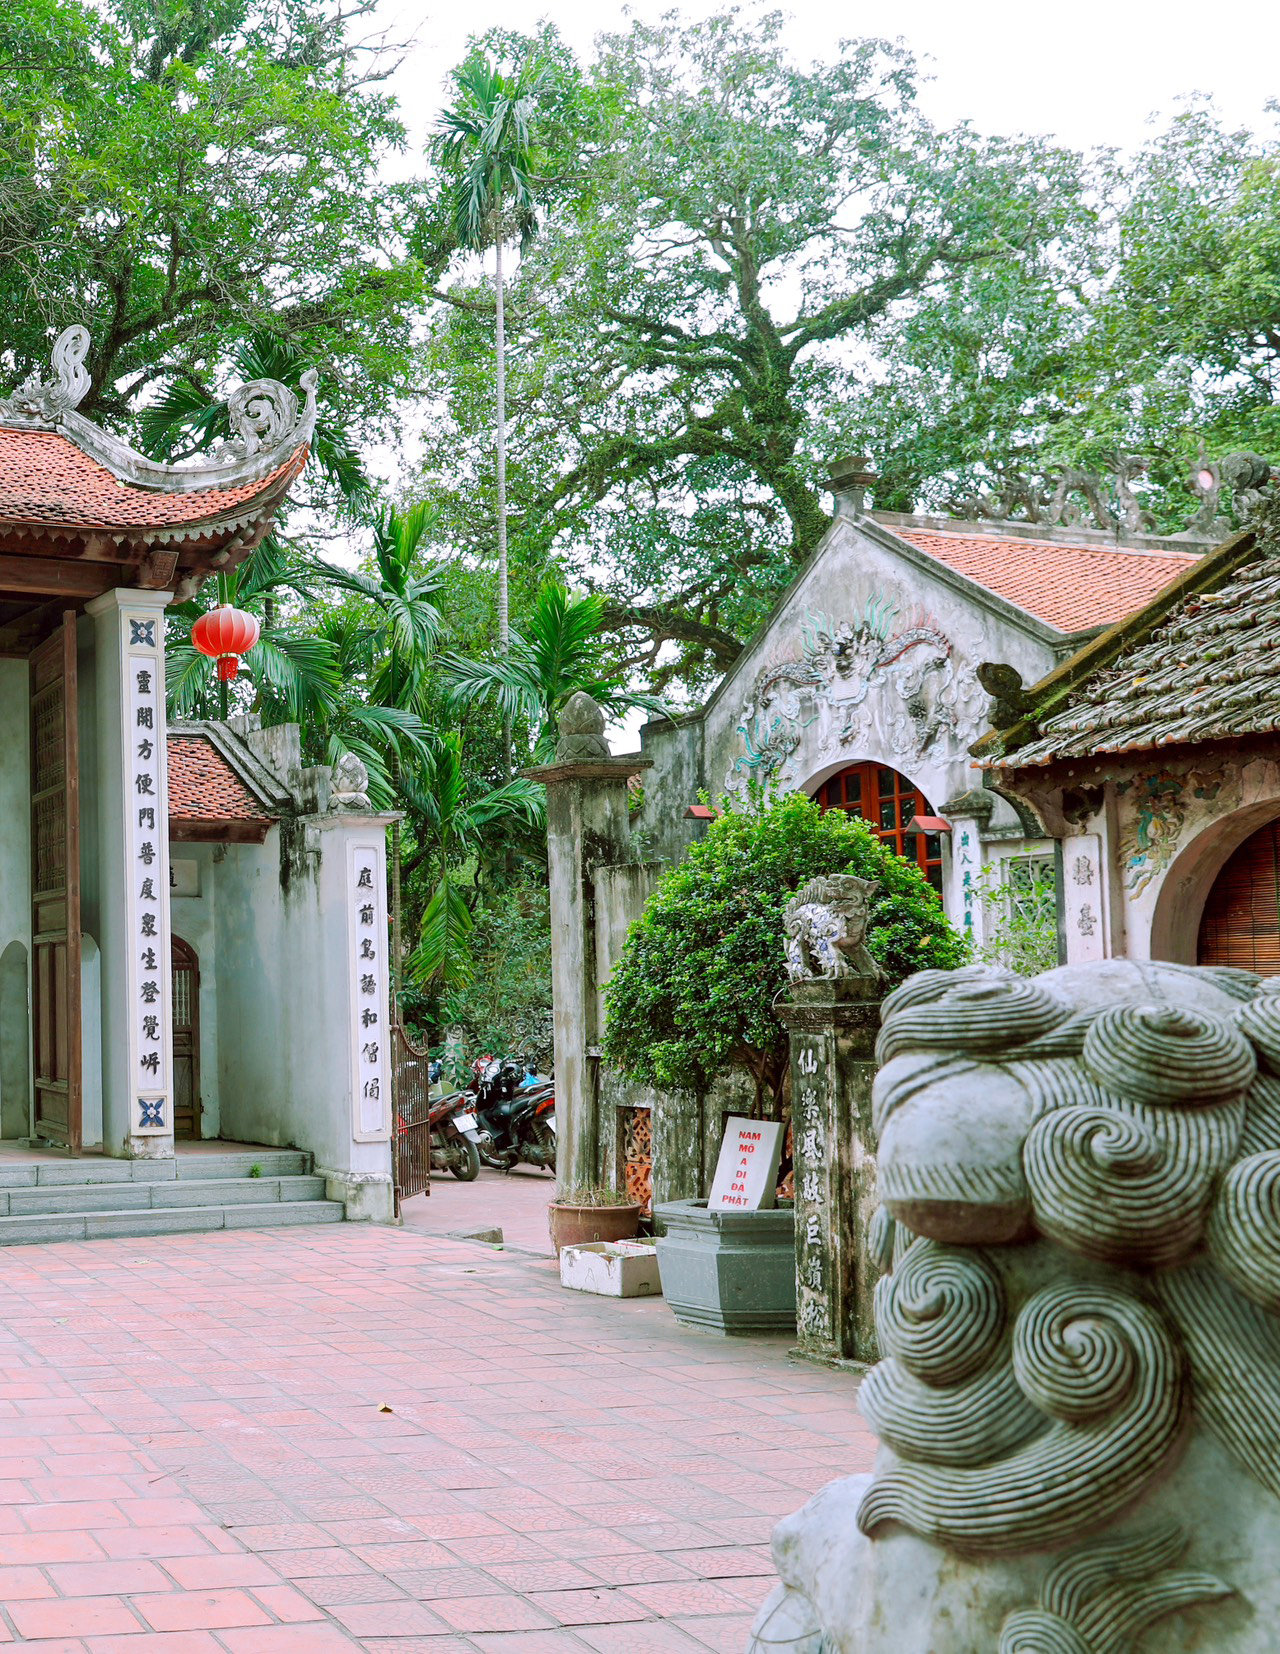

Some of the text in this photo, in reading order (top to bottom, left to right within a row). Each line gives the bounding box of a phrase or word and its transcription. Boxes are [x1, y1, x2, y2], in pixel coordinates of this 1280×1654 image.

[738, 1130, 762, 1141] NAM
[738, 1144, 755, 1153] MÔ
[740, 1158, 747, 1166] A
[736, 1170, 746, 1178] DI
[722, 1194, 749, 1206] PHẬT
